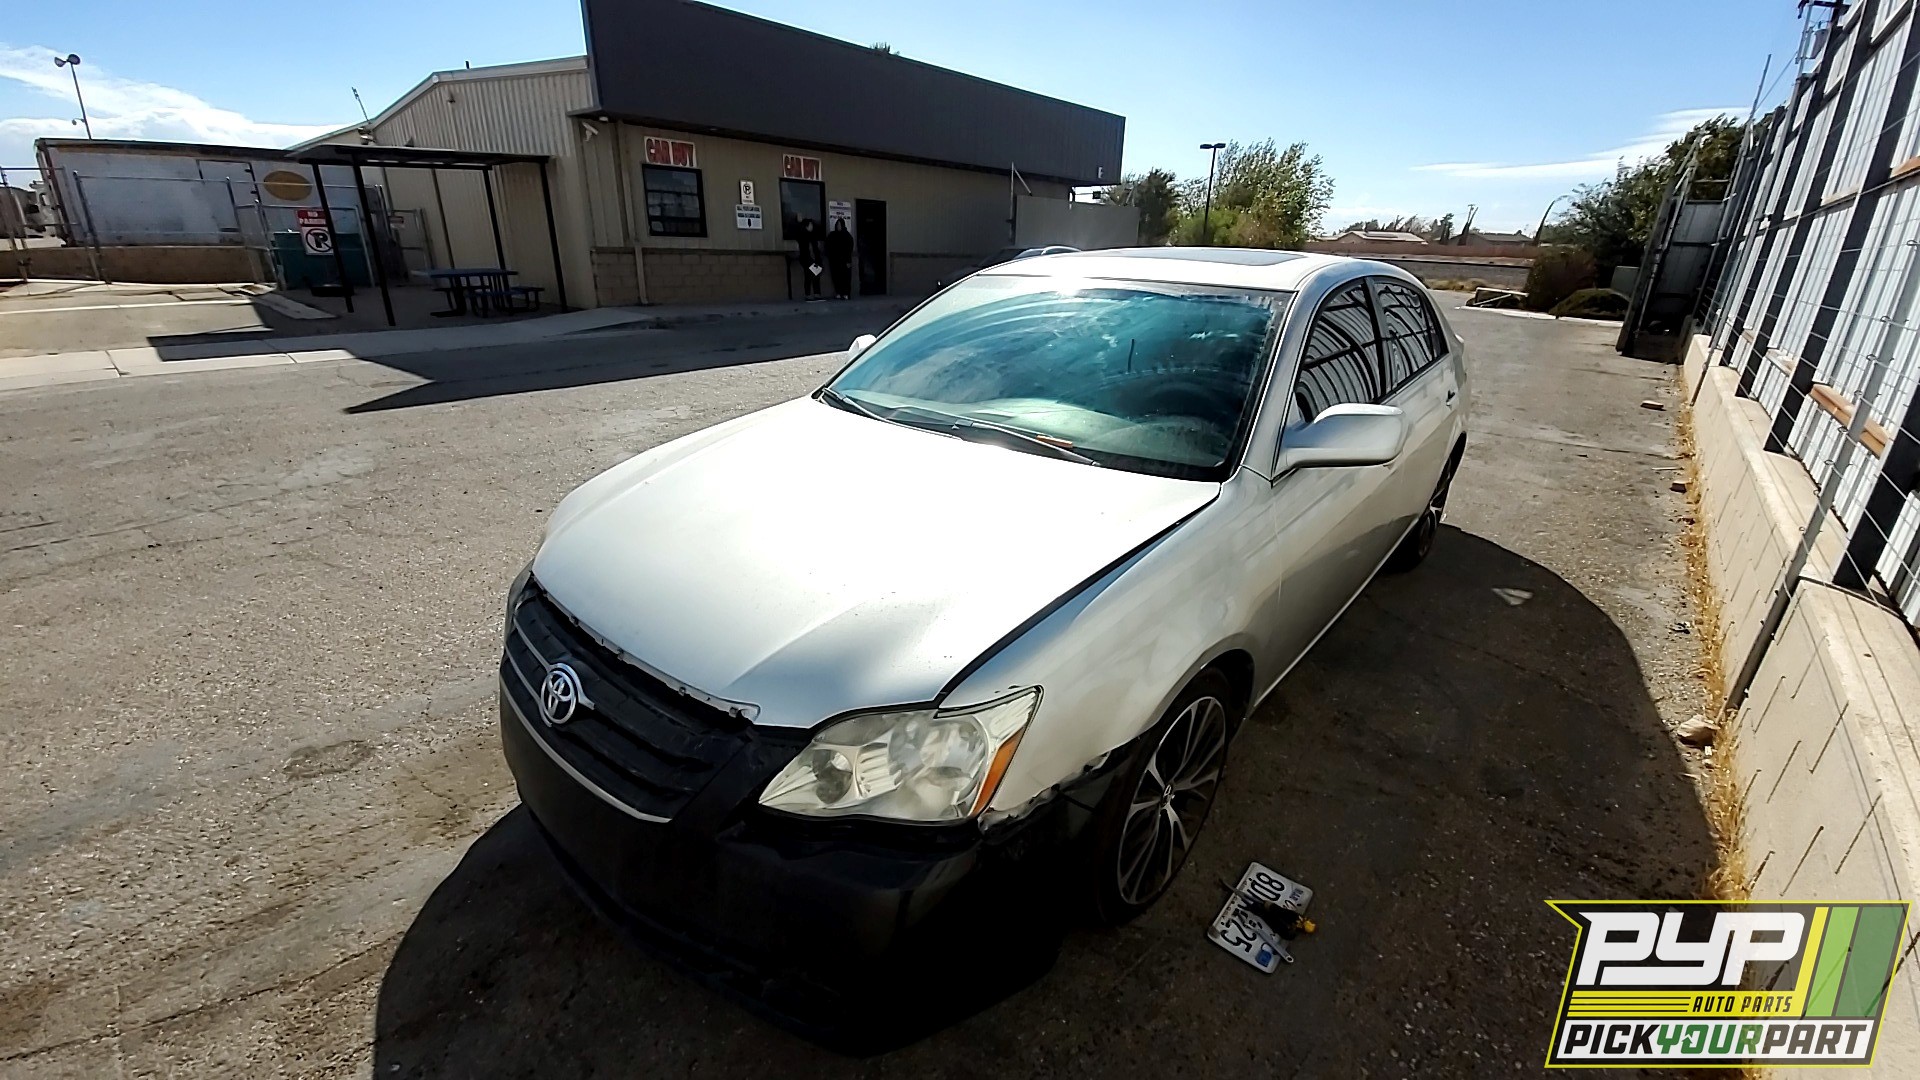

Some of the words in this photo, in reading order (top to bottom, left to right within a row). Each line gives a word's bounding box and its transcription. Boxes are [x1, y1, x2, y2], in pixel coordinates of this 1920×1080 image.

[646, 138, 671, 164] CAR
[671, 142, 693, 167] BUY
[784, 155, 802, 178] CAR
[803, 158, 819, 180] BUY
